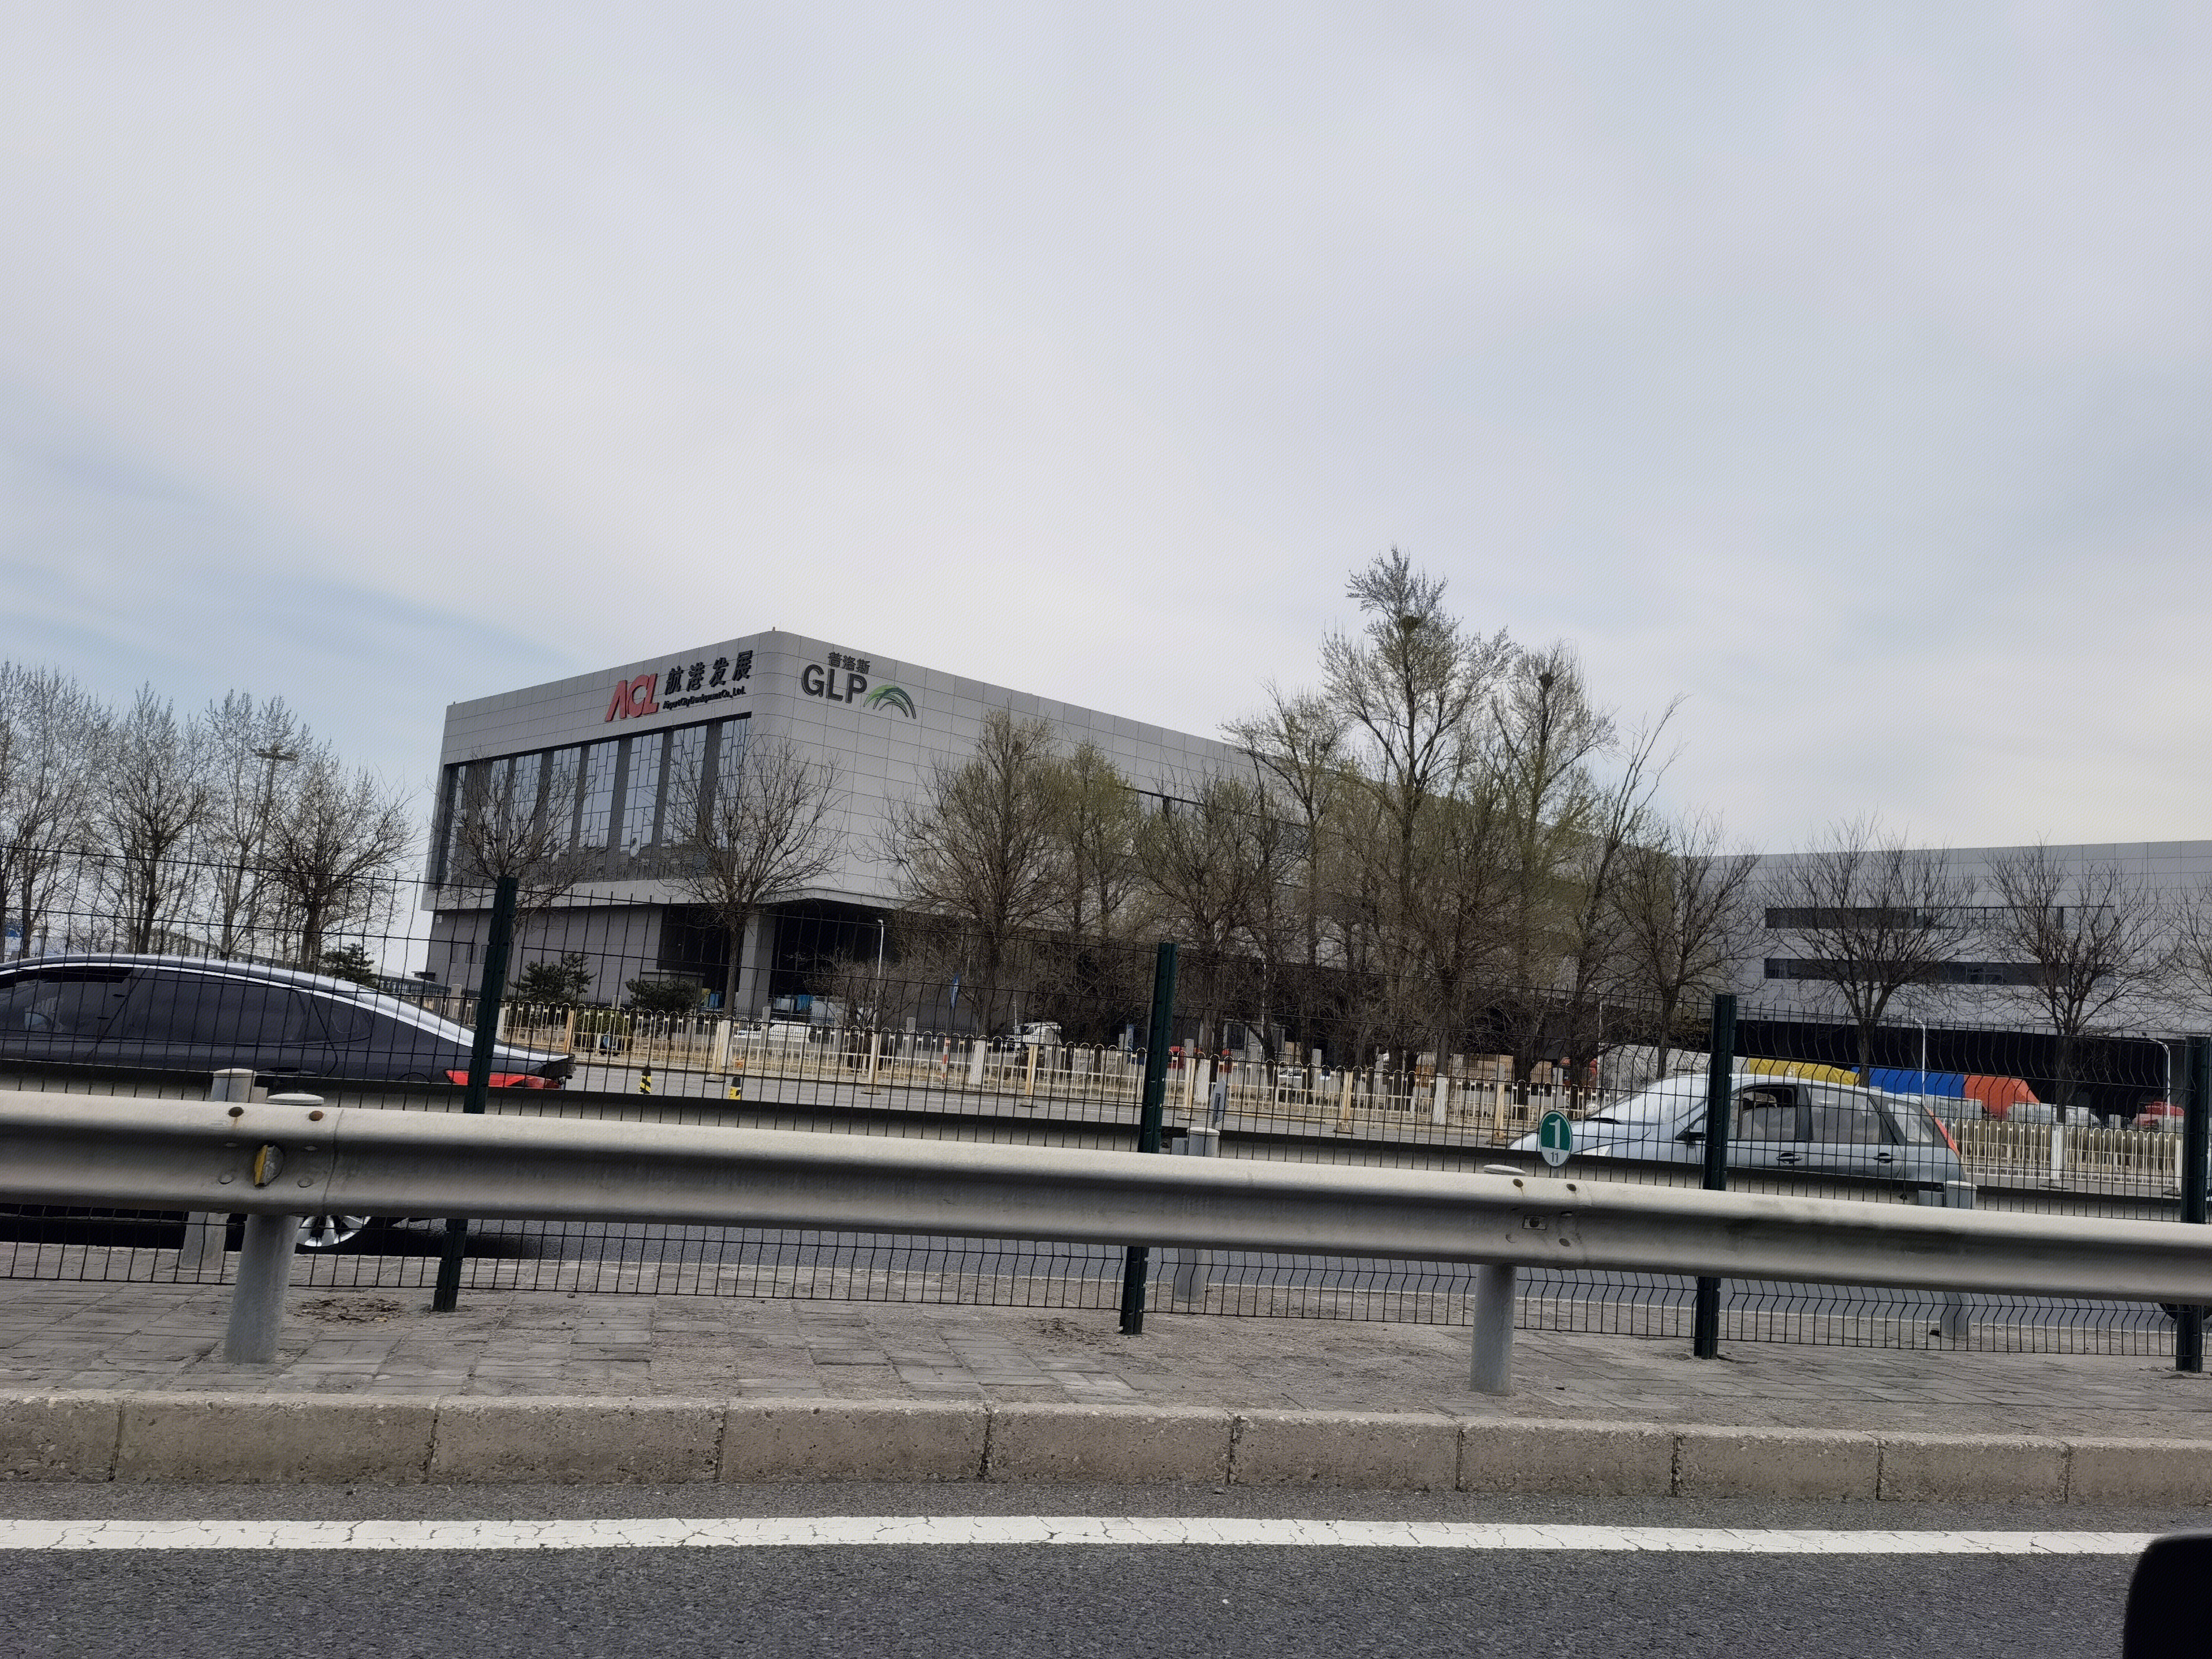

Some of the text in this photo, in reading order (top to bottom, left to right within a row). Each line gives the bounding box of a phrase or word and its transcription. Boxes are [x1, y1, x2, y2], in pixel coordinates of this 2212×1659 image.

[665, 650, 753, 696] 航港发展
[828, 652, 870, 675] 普洛斯
[604, 673, 659, 721] ACL
[801, 664, 867, 704] GLP
[1549, 1118, 1561, 1149] 1
[1550, 1151, 1559, 1163] 11
